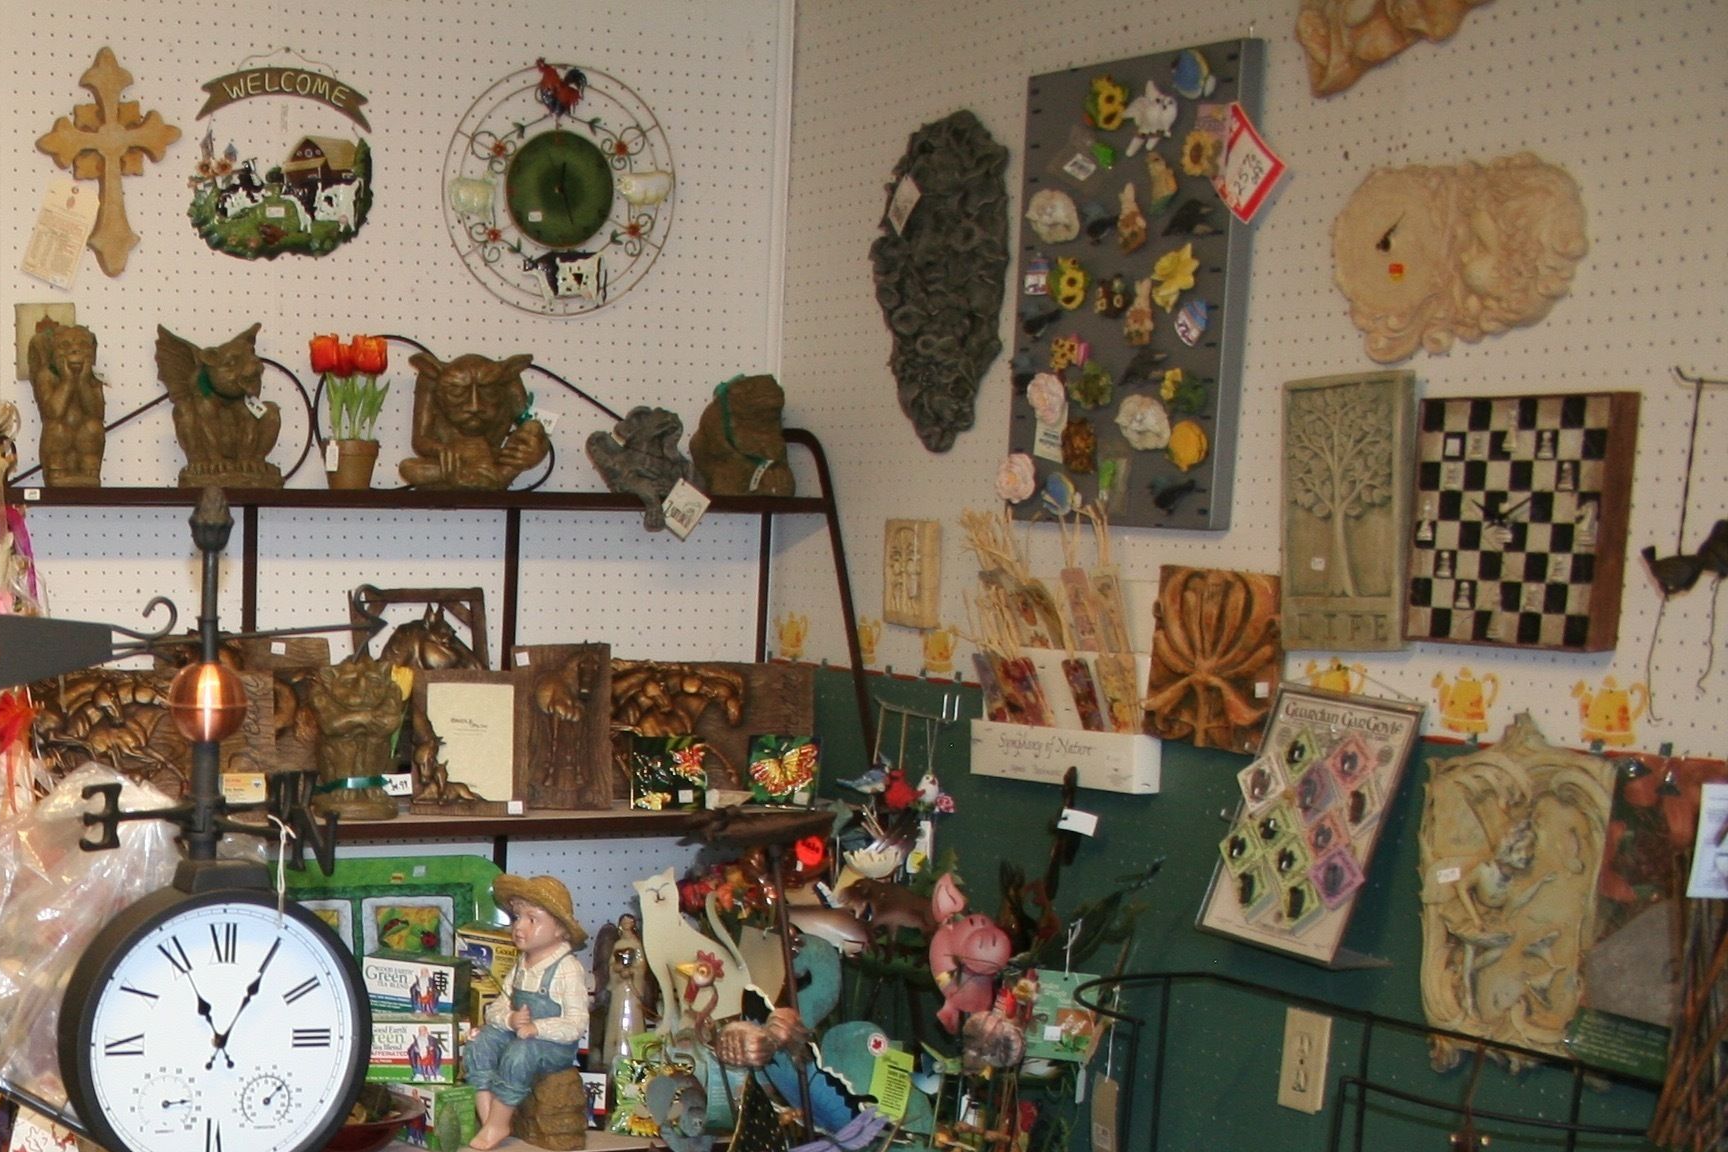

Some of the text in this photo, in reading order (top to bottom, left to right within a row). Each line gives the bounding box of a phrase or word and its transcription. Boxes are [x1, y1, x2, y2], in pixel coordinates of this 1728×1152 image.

[223, 71, 350, 107] WELCOME
[1297, 612, 1388, 641] LIFE
[365, 964, 408, 984] Green
[373, 1033, 405, 1044] reen
